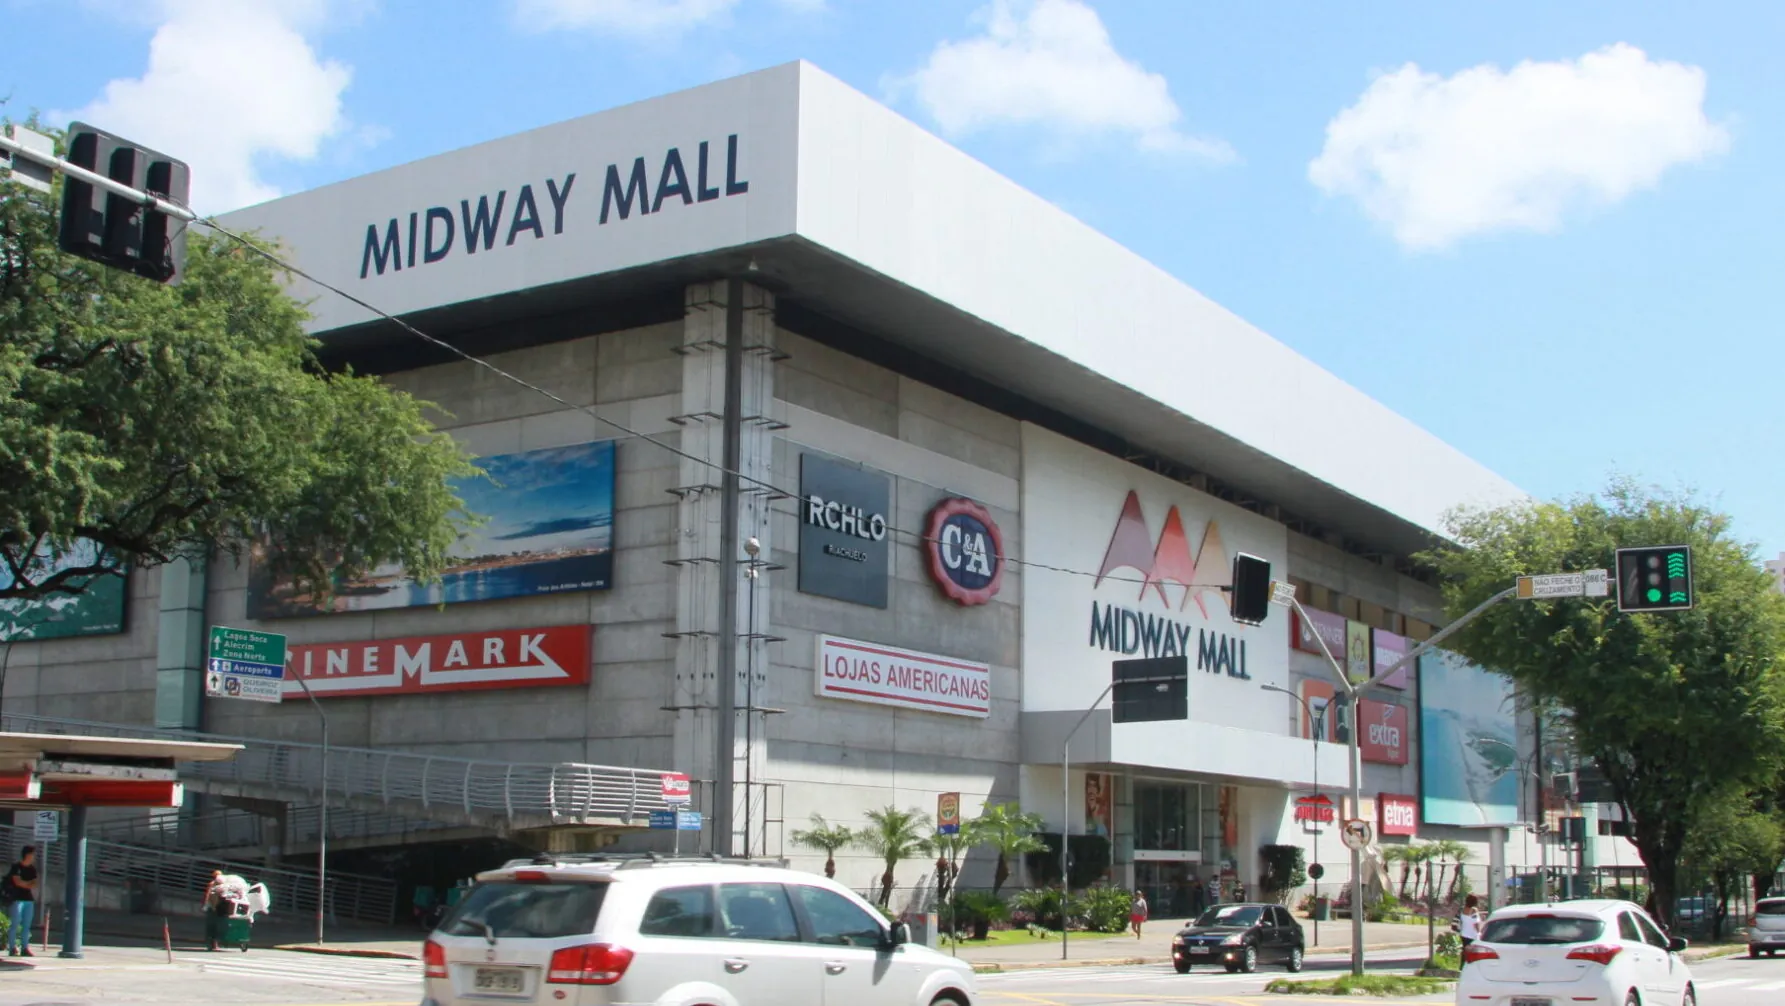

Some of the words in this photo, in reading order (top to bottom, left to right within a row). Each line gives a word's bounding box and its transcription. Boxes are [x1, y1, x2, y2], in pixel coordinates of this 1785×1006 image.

[359, 173, 576, 279] MIDWAY
[599, 133, 749, 225] MALL
[809, 495, 886, 541] RCHLO
[942, 524, 991, 577] C&A
[1534, 585, 1581, 594] CRUZAMENTO
[223, 640, 255, 651] Alecrim
[286, 634, 570, 688] INEMARK
[1089, 600, 1191, 658] MIDWAY
[1197, 627, 1252, 681] MALL
[233, 663, 273, 675] Aeroporto
[824, 653, 881, 684] LOJAS
[886, 664, 989, 701] AMERICANAS
[1369, 722, 1400, 748] extra
[1384, 800, 1414, 827] etna
